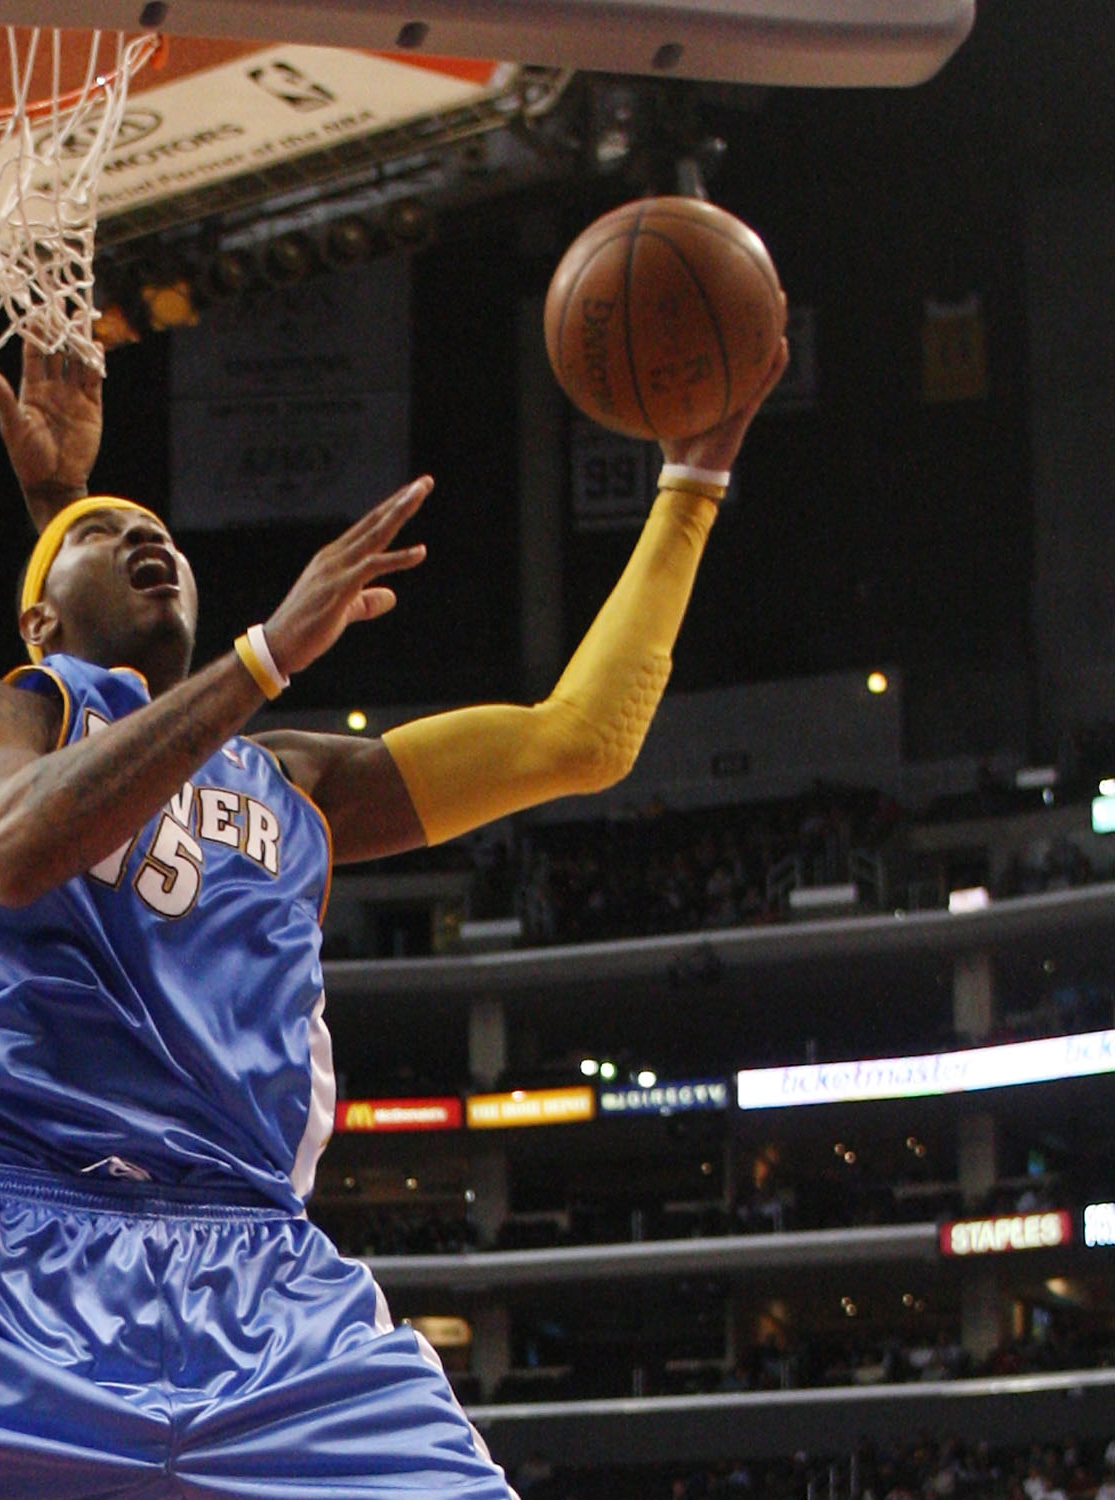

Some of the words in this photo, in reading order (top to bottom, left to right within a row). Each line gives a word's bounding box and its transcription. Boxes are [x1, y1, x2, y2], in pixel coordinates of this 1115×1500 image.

[103, 122, 245, 174] MOTORS
[626, 1083, 726, 1109] DIRECTV
[950, 1213, 1062, 1256] STAPLES
